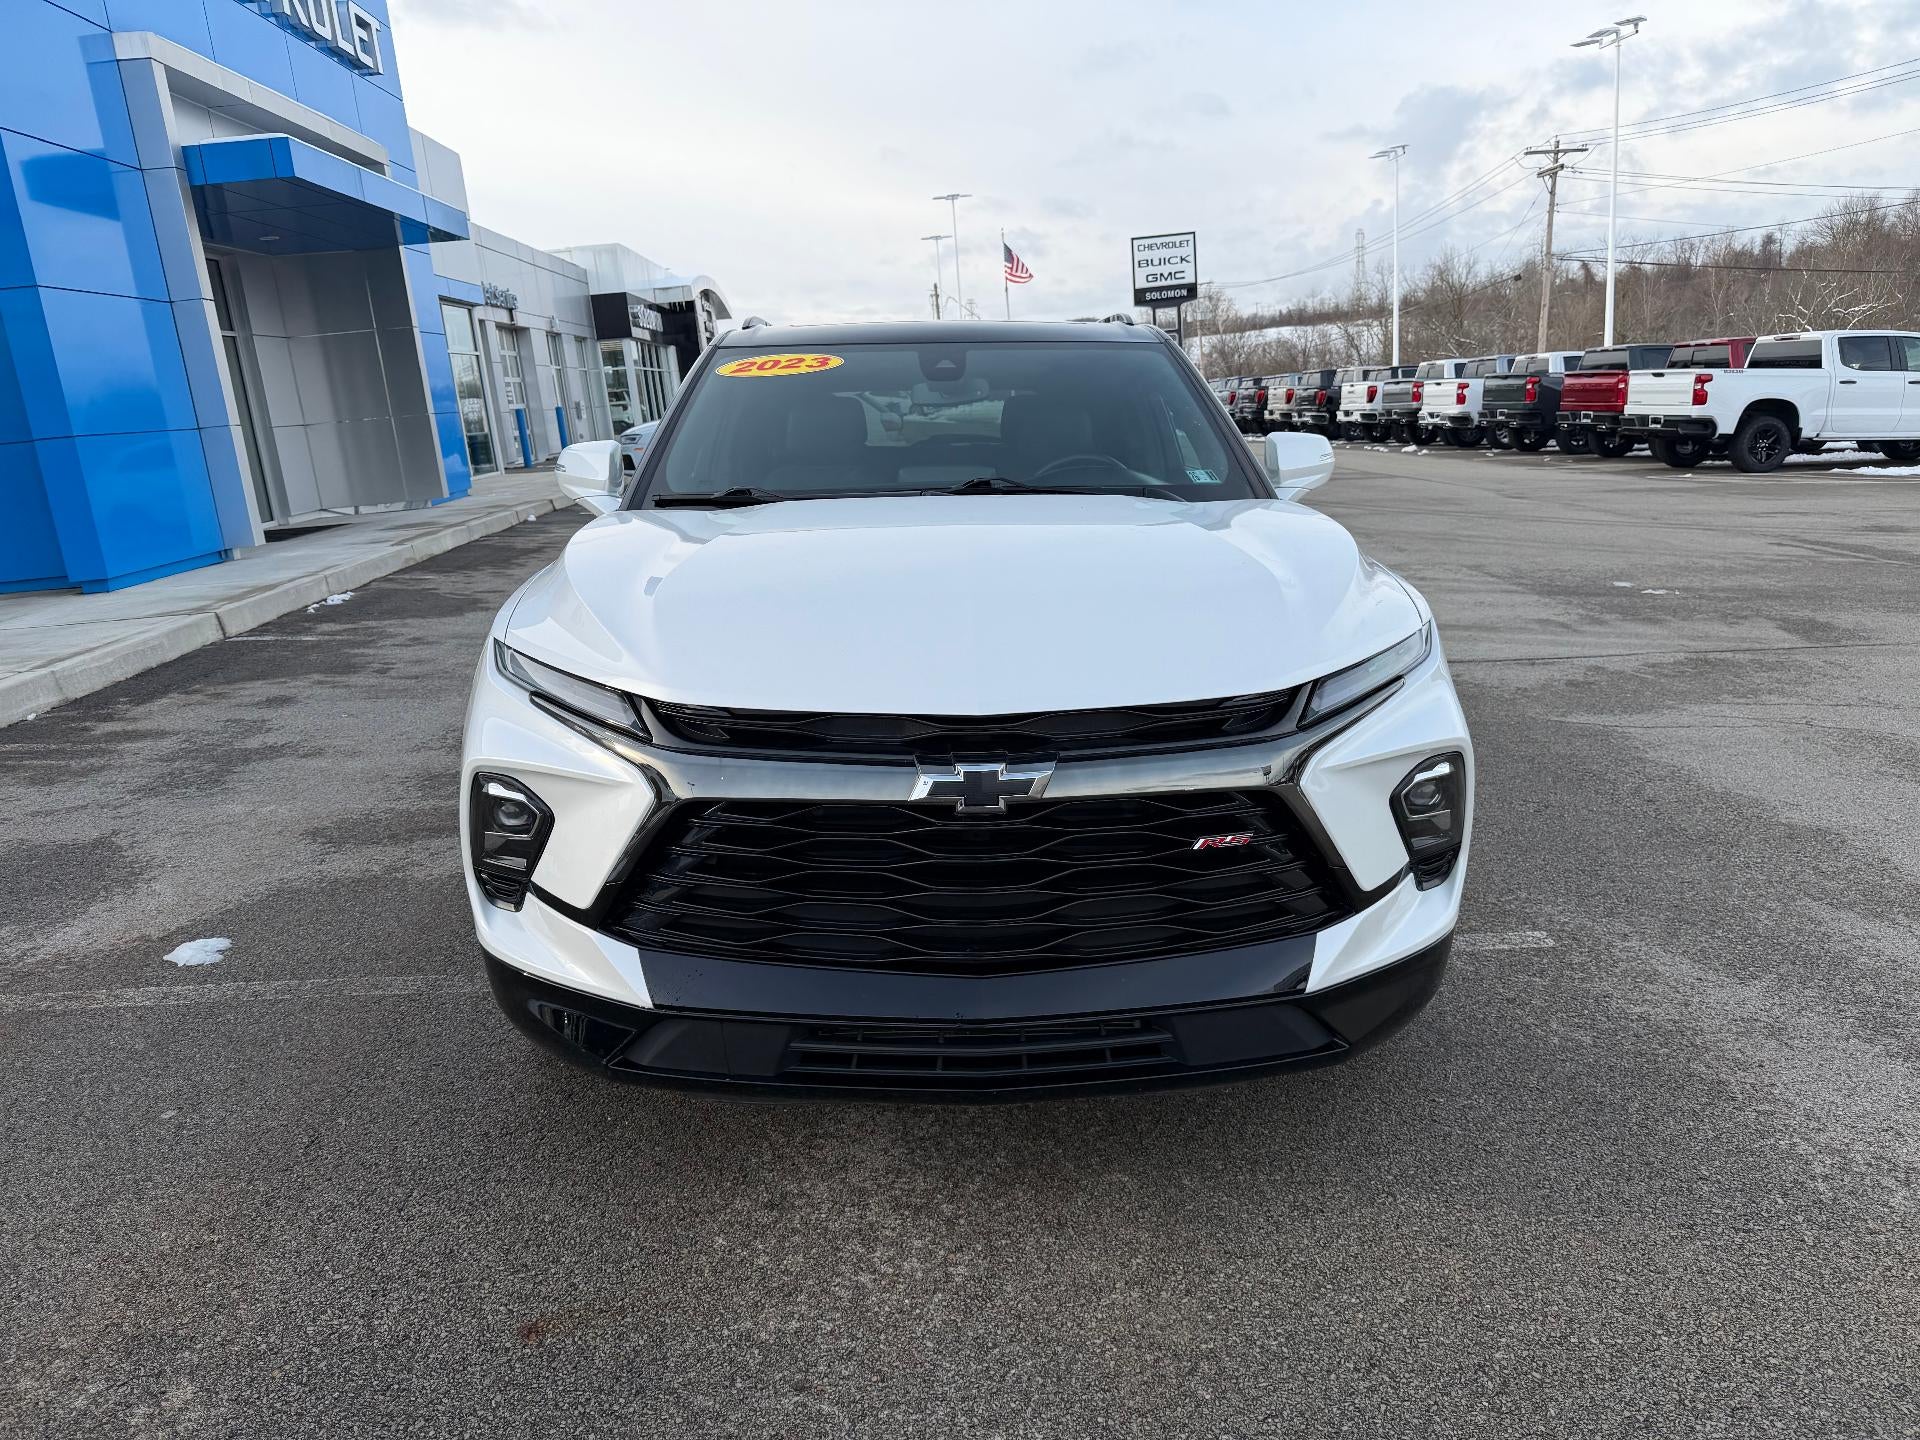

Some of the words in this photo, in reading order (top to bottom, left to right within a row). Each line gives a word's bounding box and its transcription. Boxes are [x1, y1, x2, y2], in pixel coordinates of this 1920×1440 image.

[1137, 240, 1190, 252] CHEVROLET
[1137, 255, 1191, 268] BUICK
[1146, 271, 1185, 283] GMC
[1145, 289, 1187, 301] SOLOMON
[729, 356, 832, 374] 2023
[1193, 833, 1253, 849] RS
